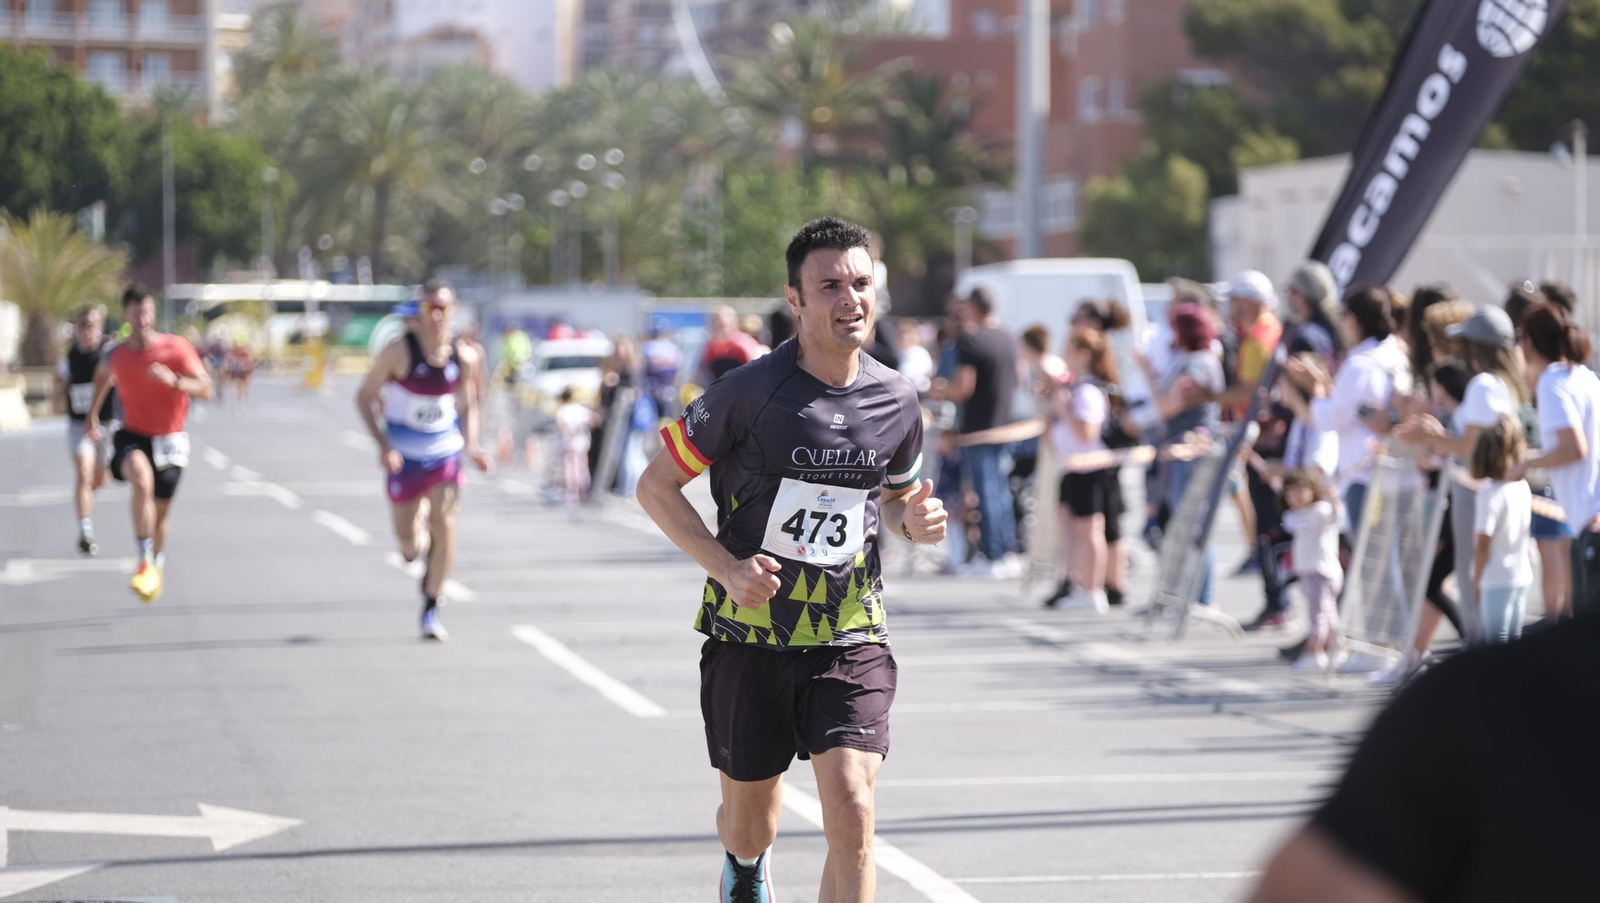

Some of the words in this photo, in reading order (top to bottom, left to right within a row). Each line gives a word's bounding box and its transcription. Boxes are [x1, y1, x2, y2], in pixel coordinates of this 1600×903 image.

[1326, 42, 1468, 300] acamos
[791, 446, 877, 467] CUELLAR
[799, 472, 835, 481] STONE
[838, 472, 863, 481] 1958
[780, 508, 848, 548] 473
